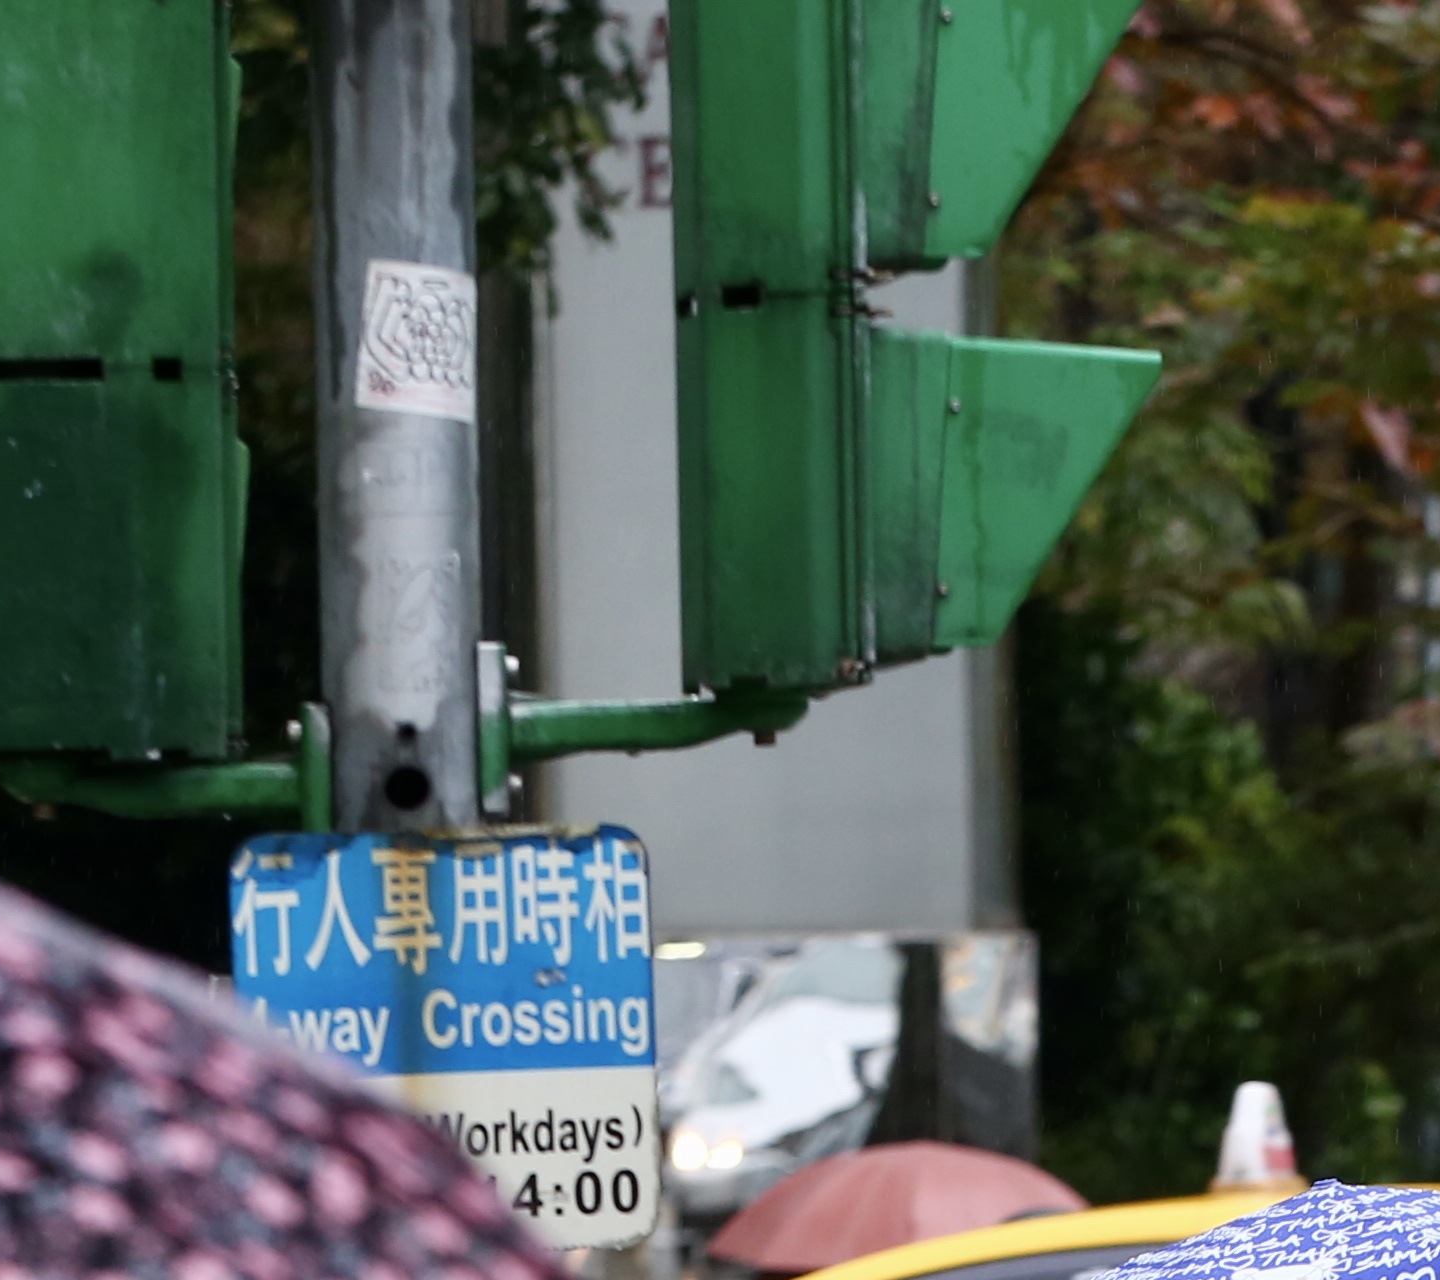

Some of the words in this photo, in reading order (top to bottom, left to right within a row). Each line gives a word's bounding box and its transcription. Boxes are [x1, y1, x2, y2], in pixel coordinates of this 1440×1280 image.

[231, 838, 649, 977] 行人專用時相
[422, 985, 648, 1056] Crossing
[488, 1170, 640, 1216] 4:00
